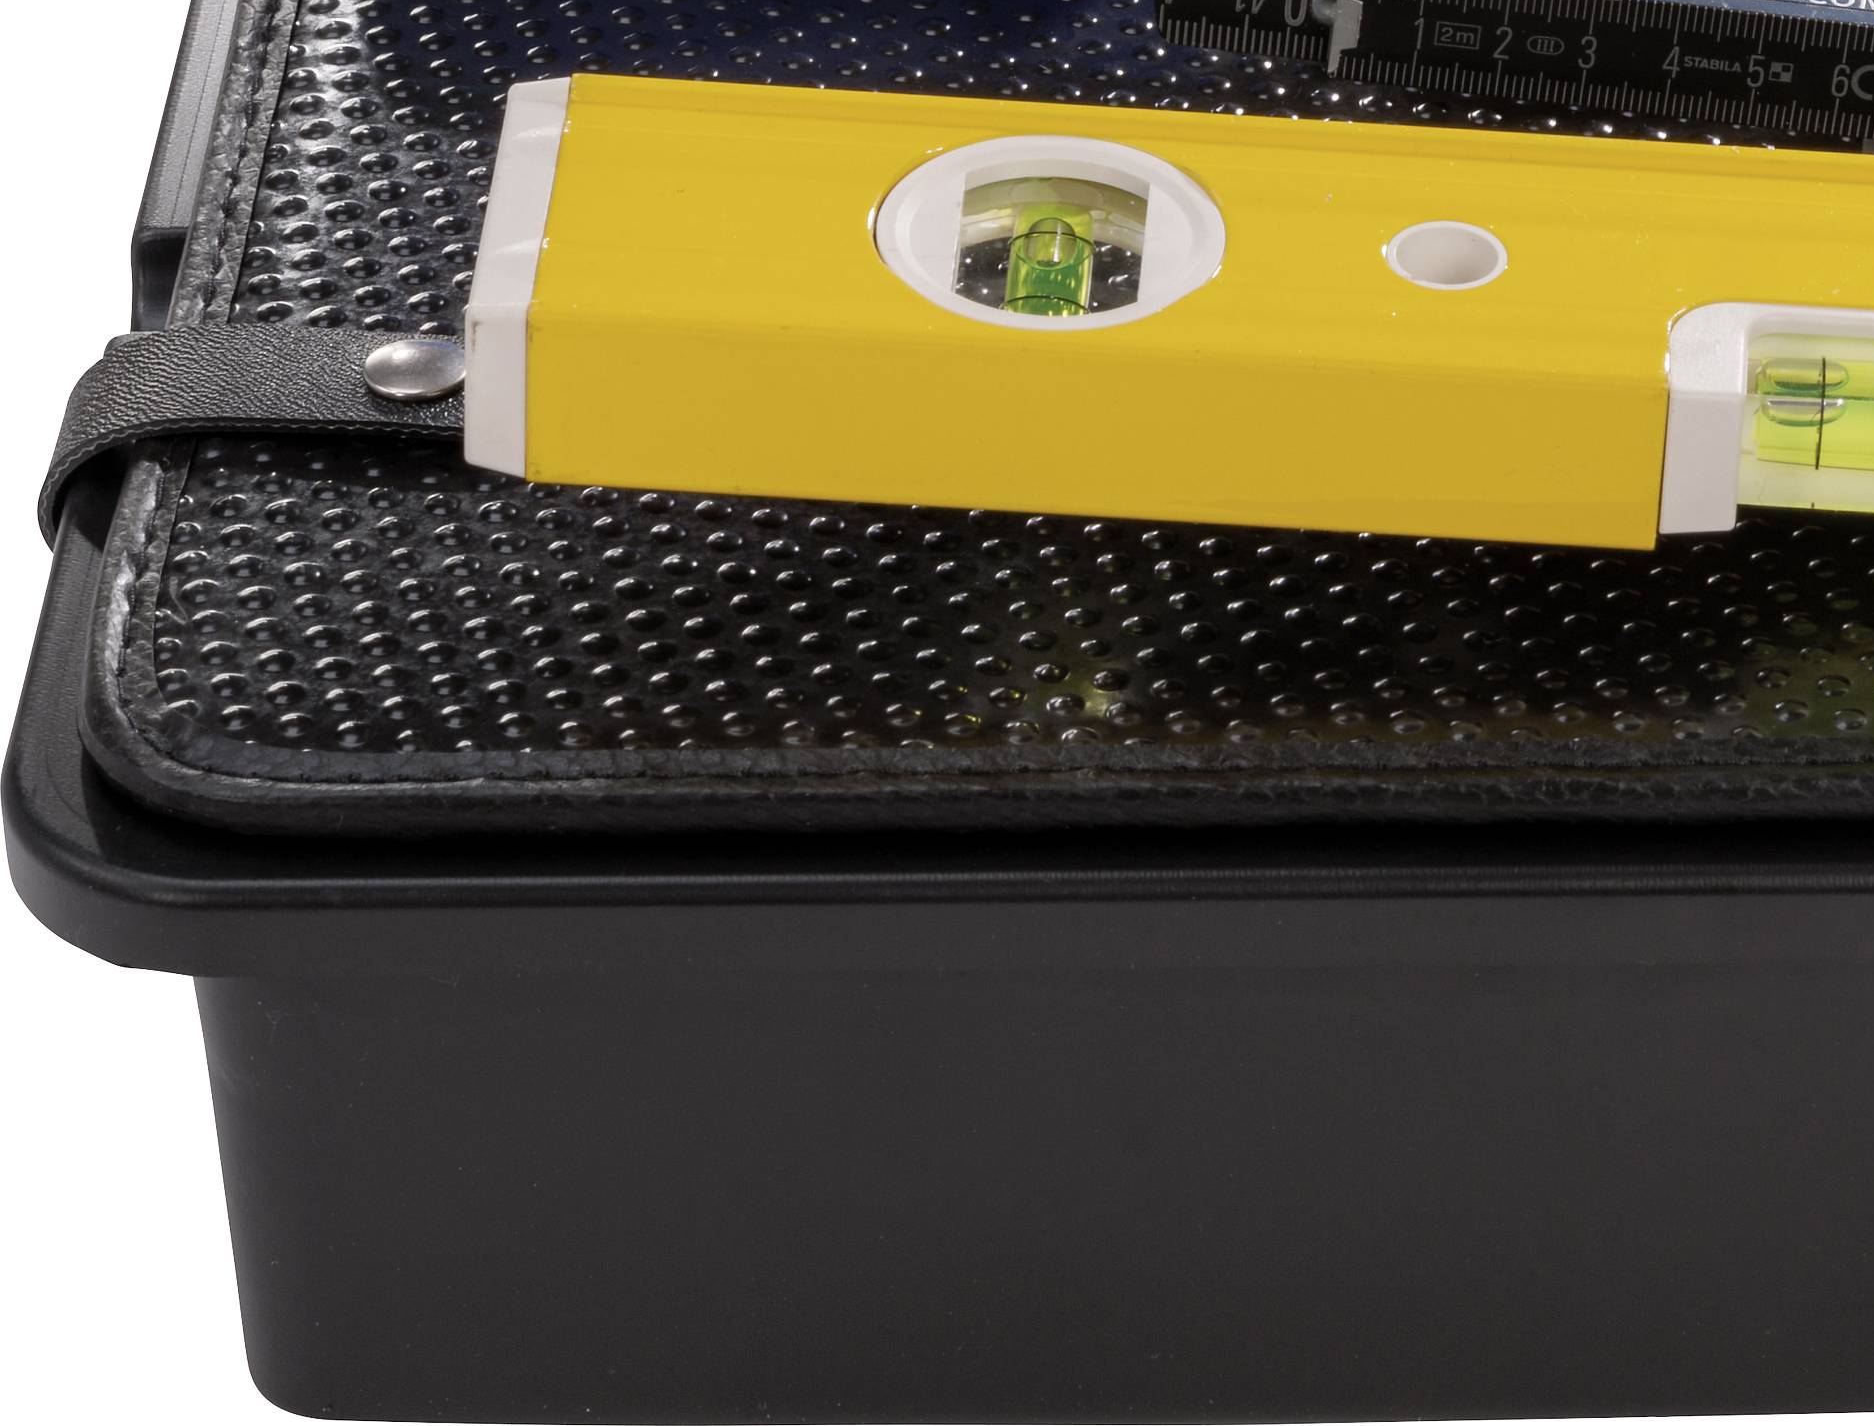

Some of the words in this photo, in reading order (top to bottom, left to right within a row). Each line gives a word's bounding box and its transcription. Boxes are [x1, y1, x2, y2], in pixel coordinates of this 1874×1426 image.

[1413, 16, 1425, 50] 1
[1440, 26, 1476, 46] 2m
[1493, 26, 1514, 60] 2
[1577, 35, 1599, 70] 3
[1661, 45, 1681, 79] 4
[1683, 55, 1742, 74] STABILA
[1746, 54, 1766, 88] 5
[1831, 63, 1850, 98] 6
